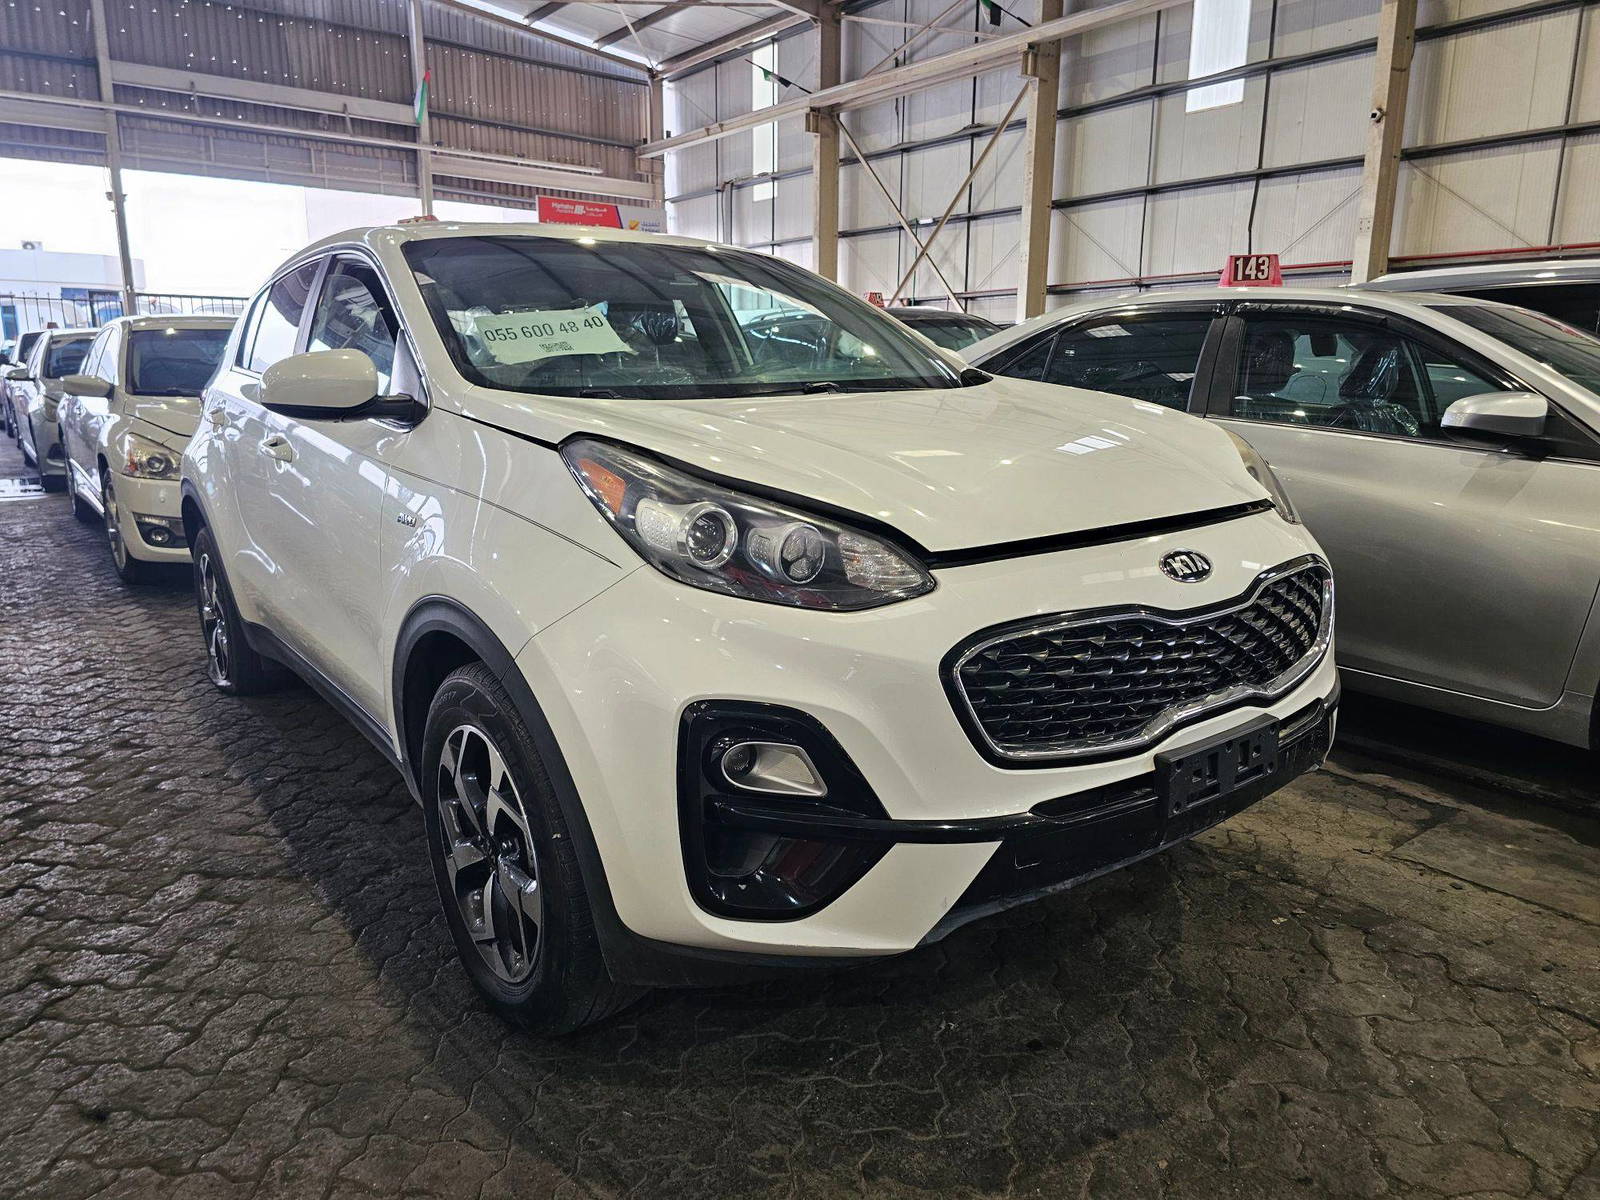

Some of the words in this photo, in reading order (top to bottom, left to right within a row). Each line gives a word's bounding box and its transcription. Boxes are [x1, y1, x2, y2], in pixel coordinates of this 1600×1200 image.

[1236, 256, 1269, 280] 143
[484, 327, 518, 342] 055
[521, 322, 555, 339] 600
[559, 321, 580, 334] 48
[583, 315, 604, 329] 40
[1166, 554, 1210, 576] KIA
